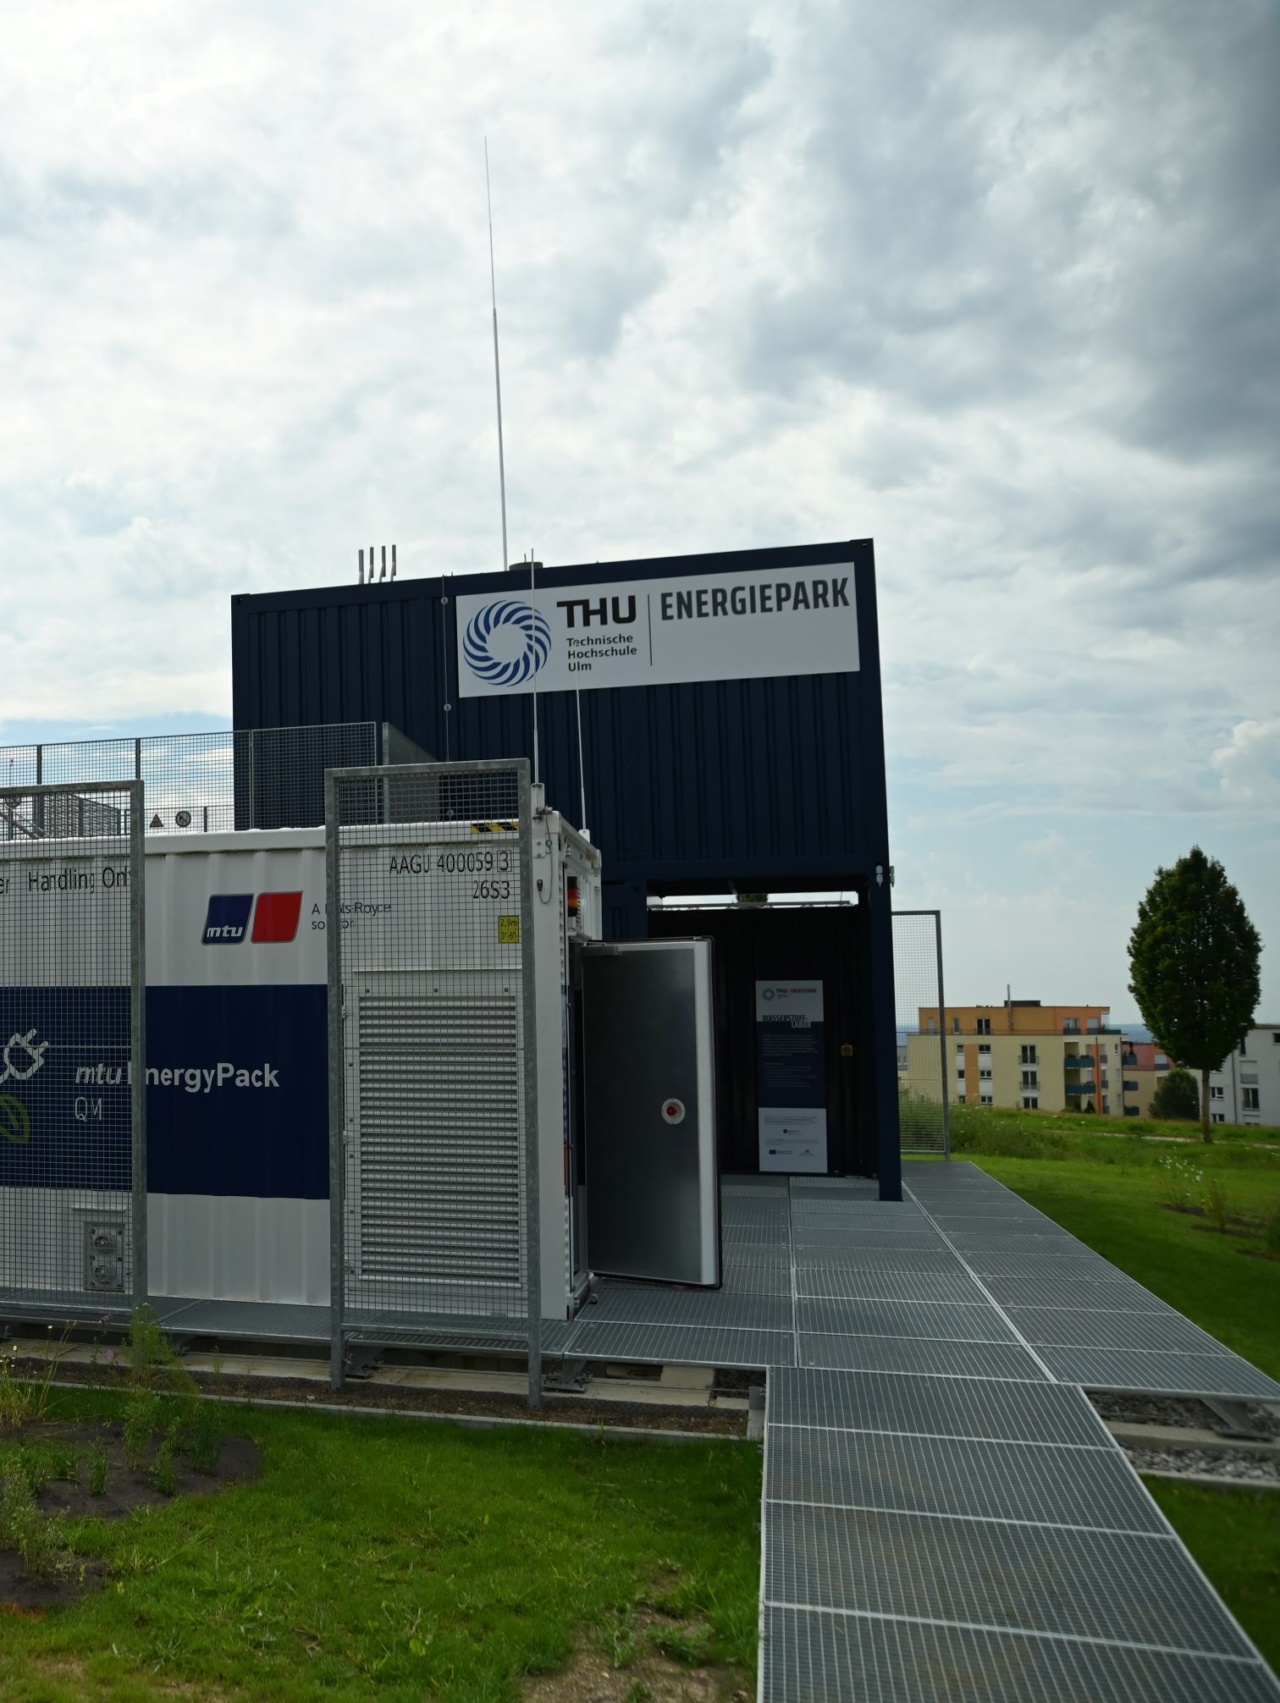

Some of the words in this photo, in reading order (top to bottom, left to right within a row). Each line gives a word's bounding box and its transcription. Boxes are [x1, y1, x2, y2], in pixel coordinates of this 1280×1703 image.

[557, 595, 637, 628] THU
[661, 577, 850, 621] ENERGIEPARK
[566, 633, 634, 648] Technische
[567, 645, 638, 660] Hochschule
[568, 660, 592, 672] Ulm
[389, 854, 431, 875] AAGU
[437, 851, 493, 873] 400059
[28, 868, 95, 894] Handling
[102, 866, 132, 888] Onl
[473, 879, 510, 899] 26S3
[311, 903, 321, 915] A
[205, 924, 244, 939] mtu
[75, 1062, 122, 1085] mtu
